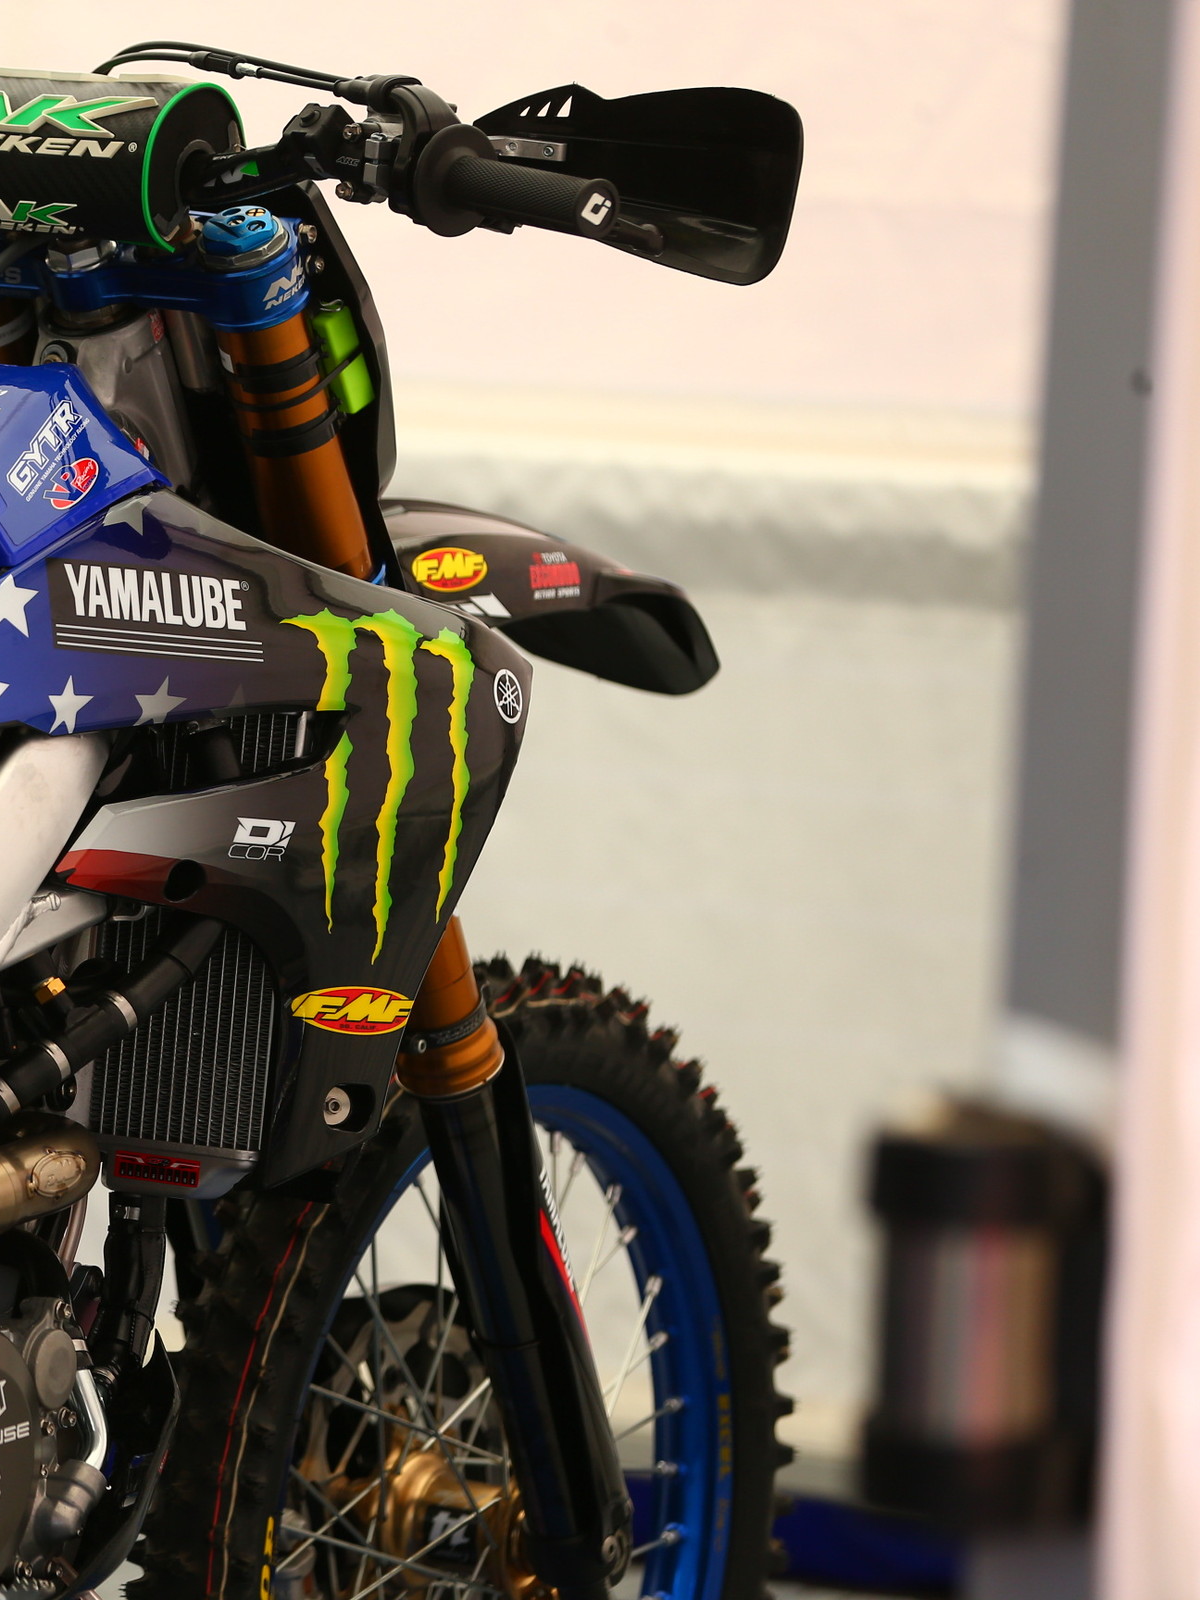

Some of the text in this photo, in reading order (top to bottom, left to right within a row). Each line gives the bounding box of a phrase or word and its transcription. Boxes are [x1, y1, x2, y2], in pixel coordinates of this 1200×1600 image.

[6, 399, 83, 497] GYTR
[25, 417, 91, 503] GENUINE YAMAHA TECHNOLOGY RACING
[416, 550, 485, 583] FMF
[540, 551, 568, 564] TOYOTA
[63, 563, 248, 631] YAMALUBE
[228, 843, 286, 862] COR
[292, 992, 415, 1024] FMF
